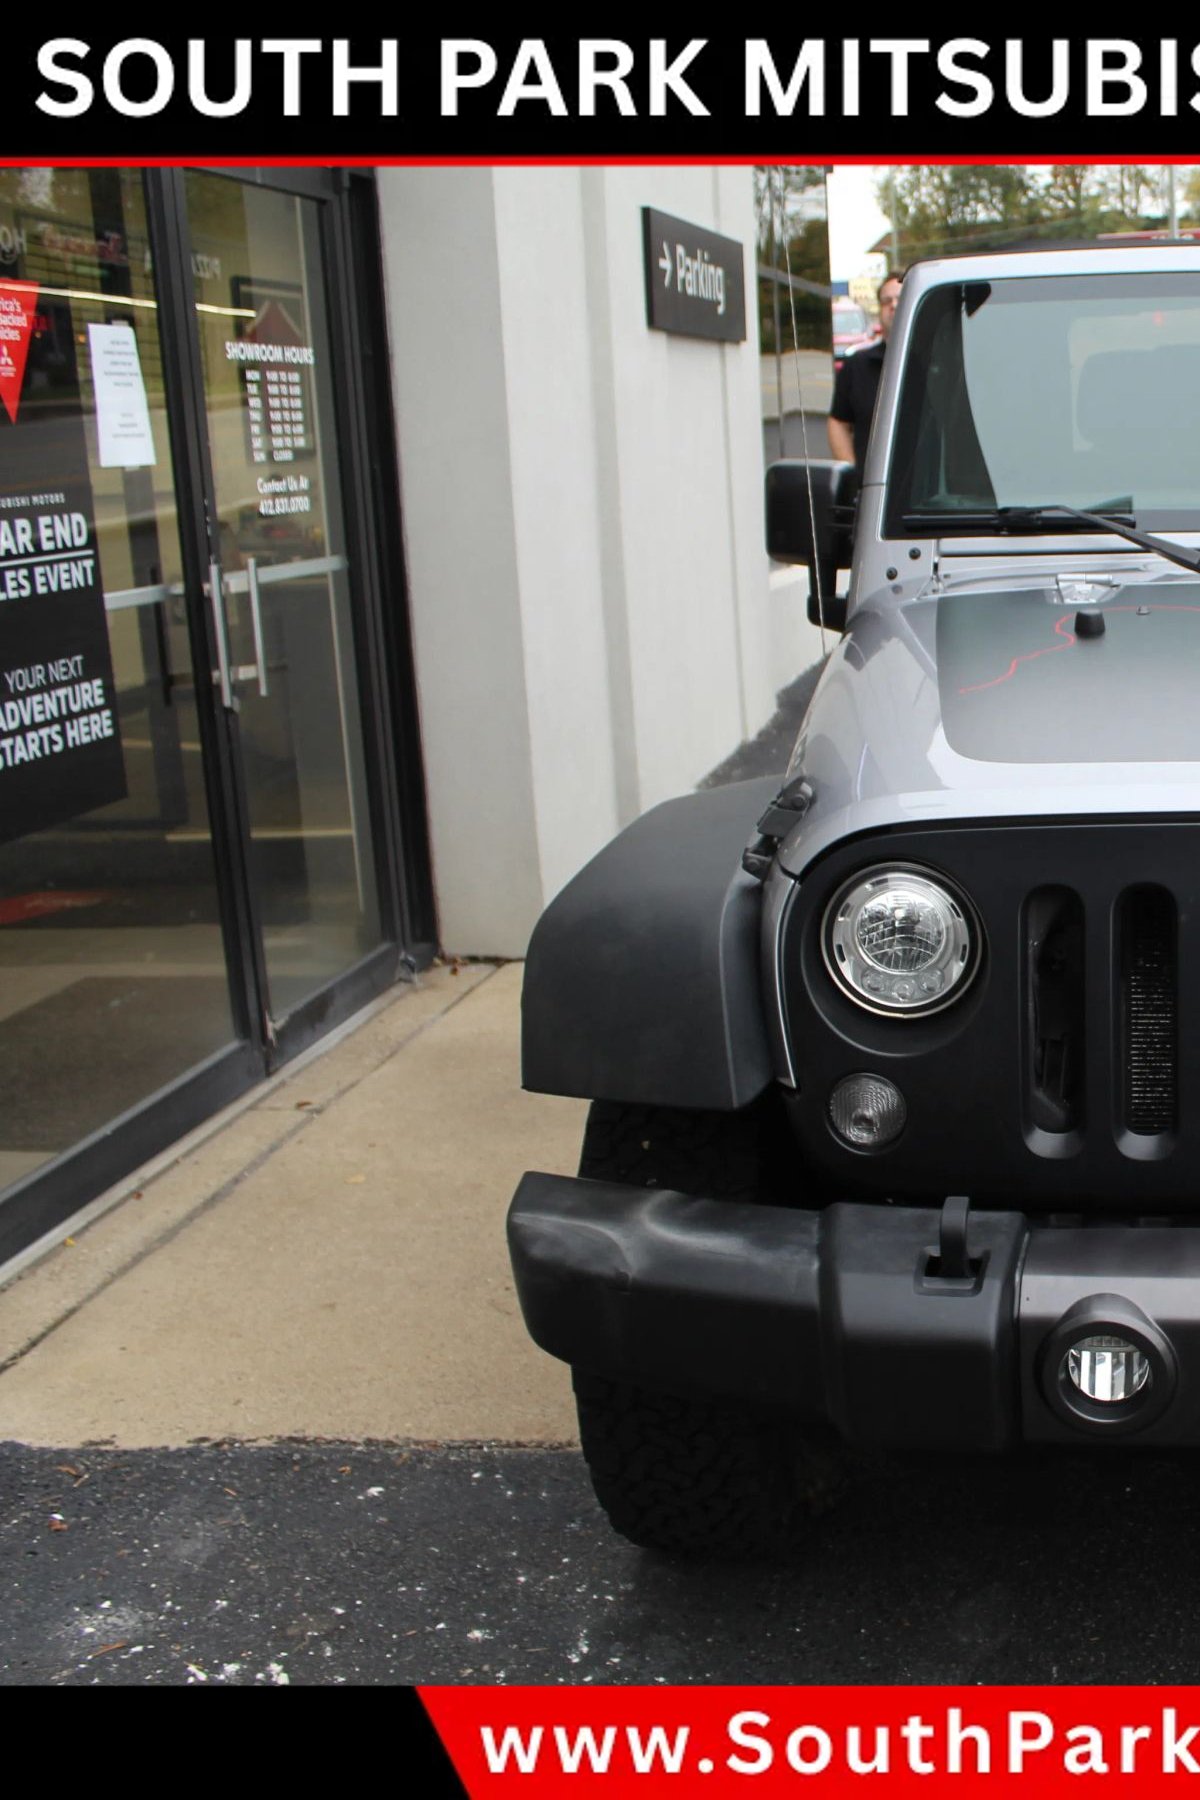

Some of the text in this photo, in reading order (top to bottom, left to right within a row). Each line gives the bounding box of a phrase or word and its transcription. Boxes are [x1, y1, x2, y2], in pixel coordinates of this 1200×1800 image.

[675, 243, 725, 315] Parking
[225, 341, 315, 365] SHOWROOM HOURS
[31, 492, 65, 506] MOTORS
[257, 477, 287, 494] Contact
[0, 512, 88, 557] AR END
[33, 559, 94, 595] EVENT
[4, 655, 84, 693] YOUR NEXT
[65, 709, 114, 748] HERE
